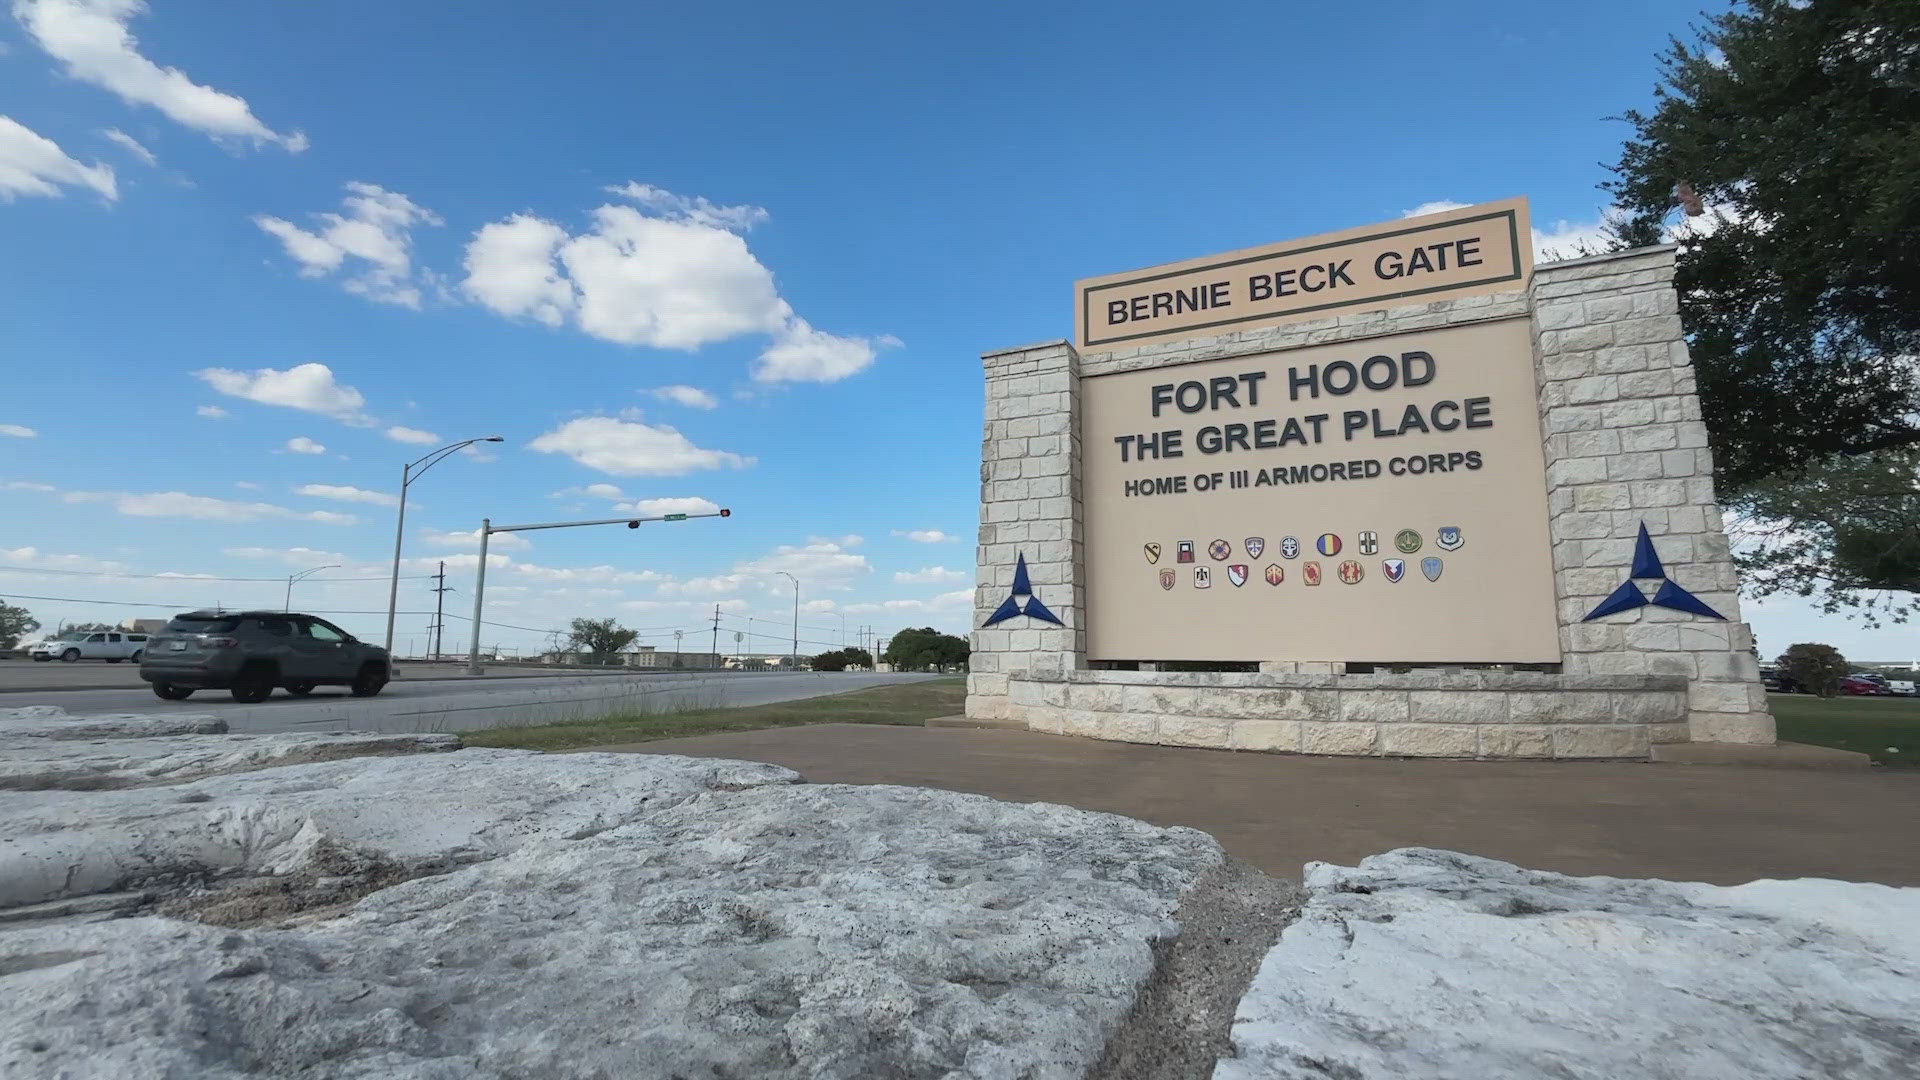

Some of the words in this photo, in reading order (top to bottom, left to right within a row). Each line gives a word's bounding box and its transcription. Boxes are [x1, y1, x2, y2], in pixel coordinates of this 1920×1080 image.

[1107, 281, 1231, 326] BERNIE
[1248, 259, 1355, 302] BECK
[1374, 237, 1484, 280] GATE
[1151, 371, 1266, 417] FORT
[1288, 350, 1437, 400] HOOD
[1114, 429, 1183, 462] THE
[1196, 413, 1329, 454] GREAT
[1343, 396, 1494, 441] PLACE
[1124, 475, 1187, 497] HOME
[1193, 471, 1224, 491] OF
[1230, 469, 1249, 489] III
[1255, 458, 1381, 488] ARMORED
[1388, 450, 1484, 477] CORPS
